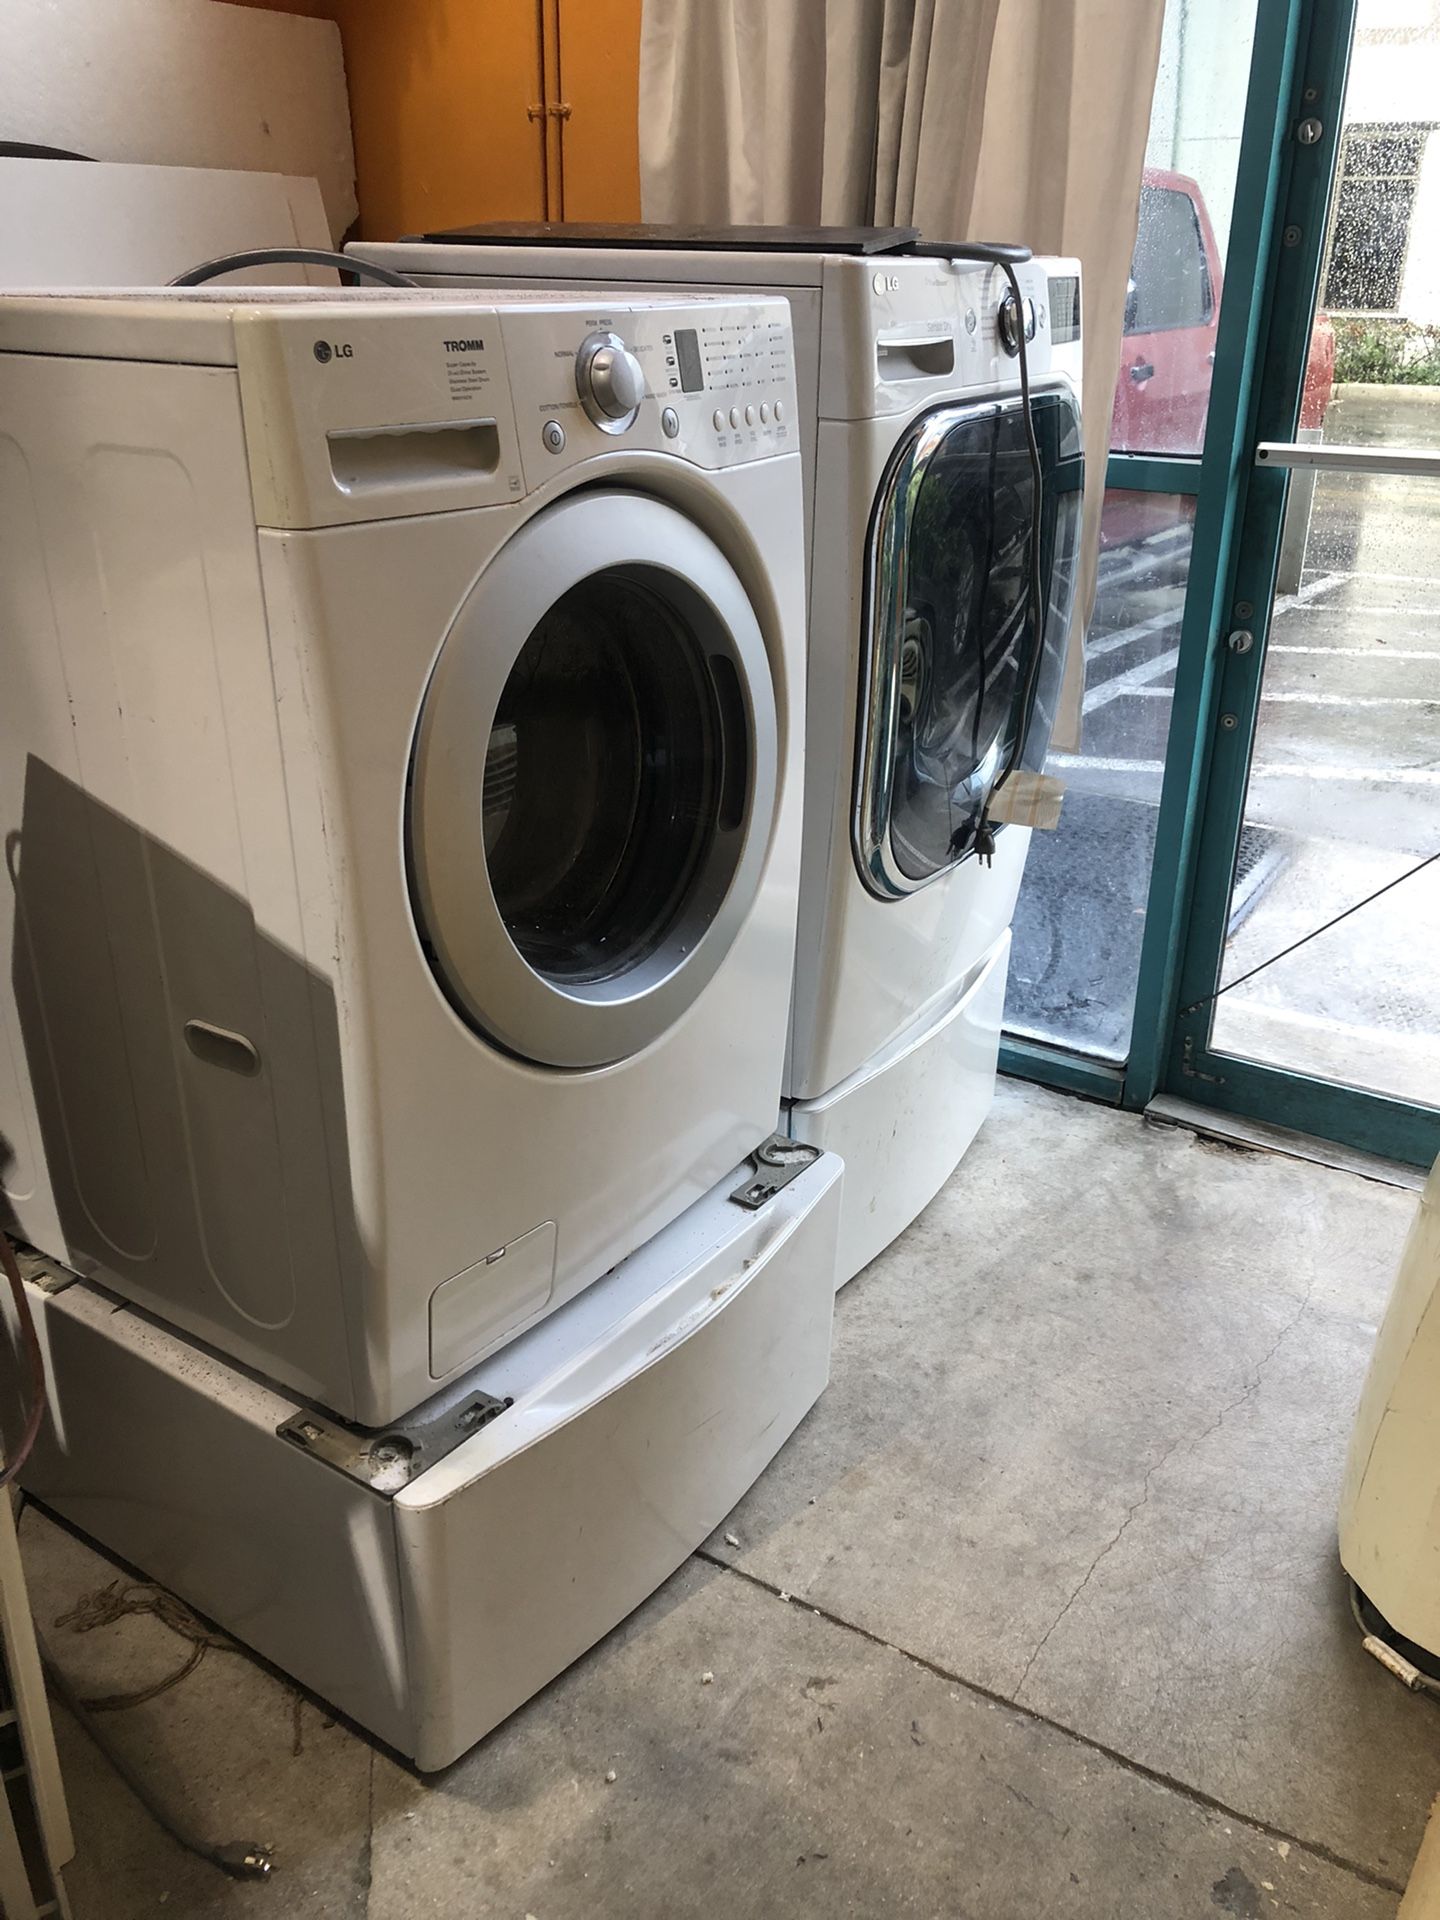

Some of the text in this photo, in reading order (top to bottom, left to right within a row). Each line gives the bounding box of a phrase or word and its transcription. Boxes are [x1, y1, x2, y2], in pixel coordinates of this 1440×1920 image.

[885, 276, 899, 291] LG
[334, 344, 353, 358] LG
[443, 339, 485, 352] TROMM
